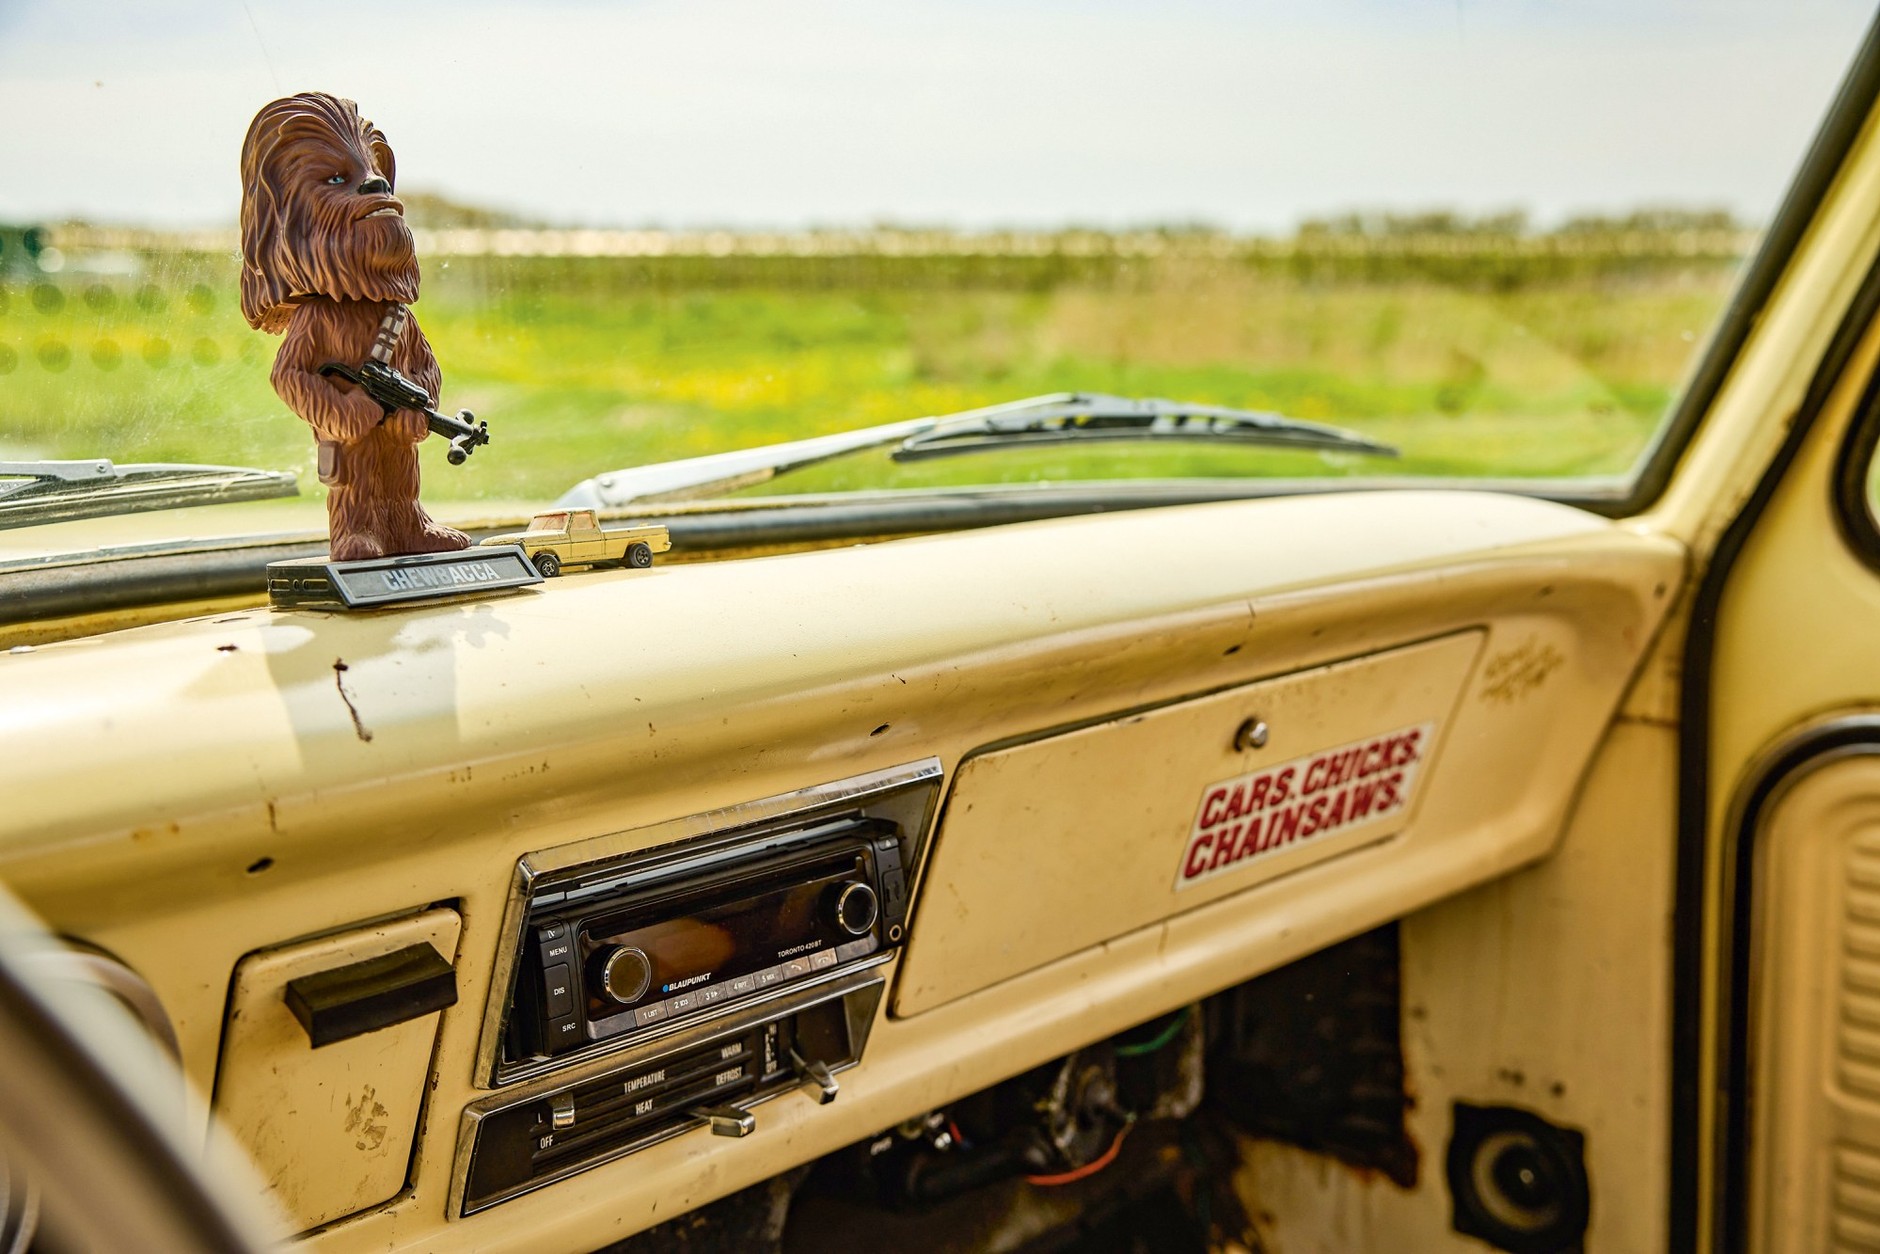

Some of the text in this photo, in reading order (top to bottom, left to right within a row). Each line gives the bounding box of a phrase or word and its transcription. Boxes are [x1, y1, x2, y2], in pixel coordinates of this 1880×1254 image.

[381, 562, 500, 591] CHEWBACCA
[1200, 729, 1421, 831] CARS. CHICKS.
[1184, 771, 1404, 880] CHAINSAWS.
[549, 945, 568, 957] MENU
[778, 944, 805, 958] TORONTO
[668, 972, 712, 991] BLAUPUNKT
[733, 982, 738, 990] 4
[761, 974, 767, 983] 5
[553, 986, 565, 996] DIS
[705, 992, 710, 1001] 3
[673, 1001, 680, 1009] 2
[643, 1011, 648, 1020] 1
[562, 1022, 576, 1032] SRC
[721, 1042, 743, 1060] WARM
[624, 1069, 665, 1095] TEMPERATURE
[716, 1066, 743, 1086] DEFROST
[635, 1098, 653, 1116] HEAT
[540, 1134, 554, 1150] OFF
